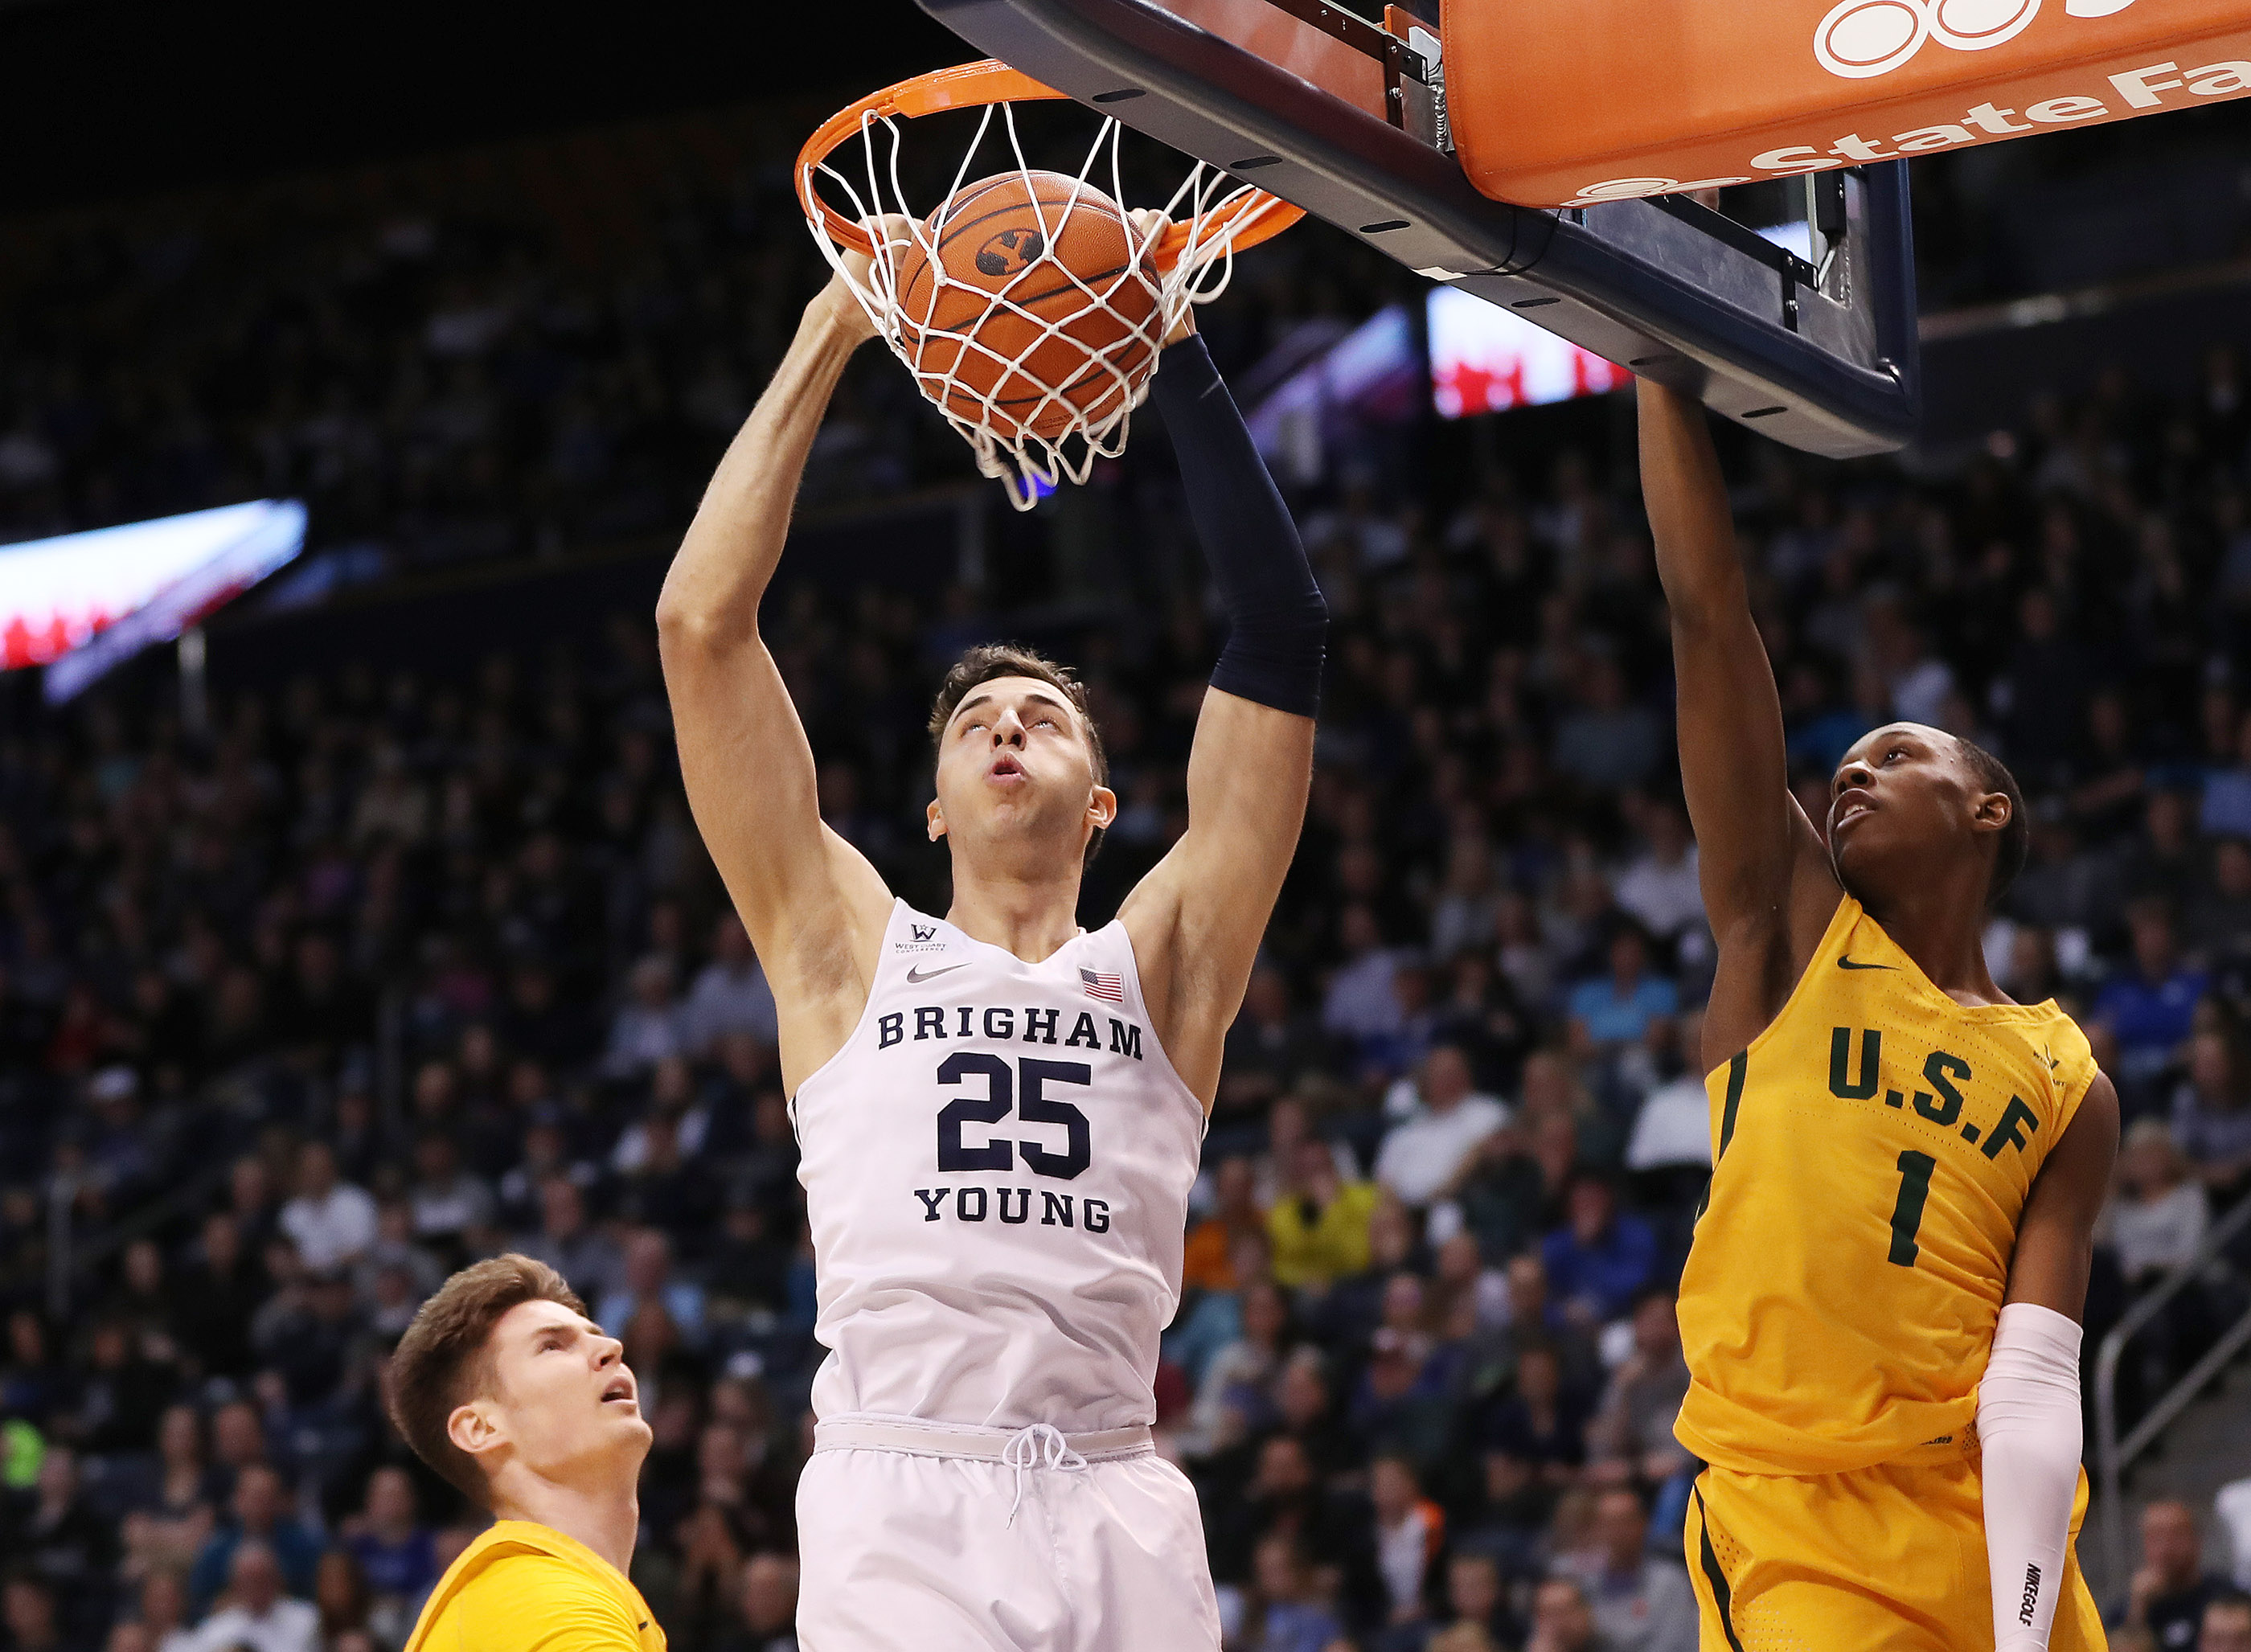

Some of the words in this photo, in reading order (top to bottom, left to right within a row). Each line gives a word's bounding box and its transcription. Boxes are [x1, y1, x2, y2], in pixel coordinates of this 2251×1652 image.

[1750, 96, 2109, 176] State
[878, 1006, 1143, 1060] BRIGHAM
[937, 1051, 1092, 1180] 25
[914, 1187, 1110, 1233] YOUNG
[1887, 1150, 1937, 1268] 1
